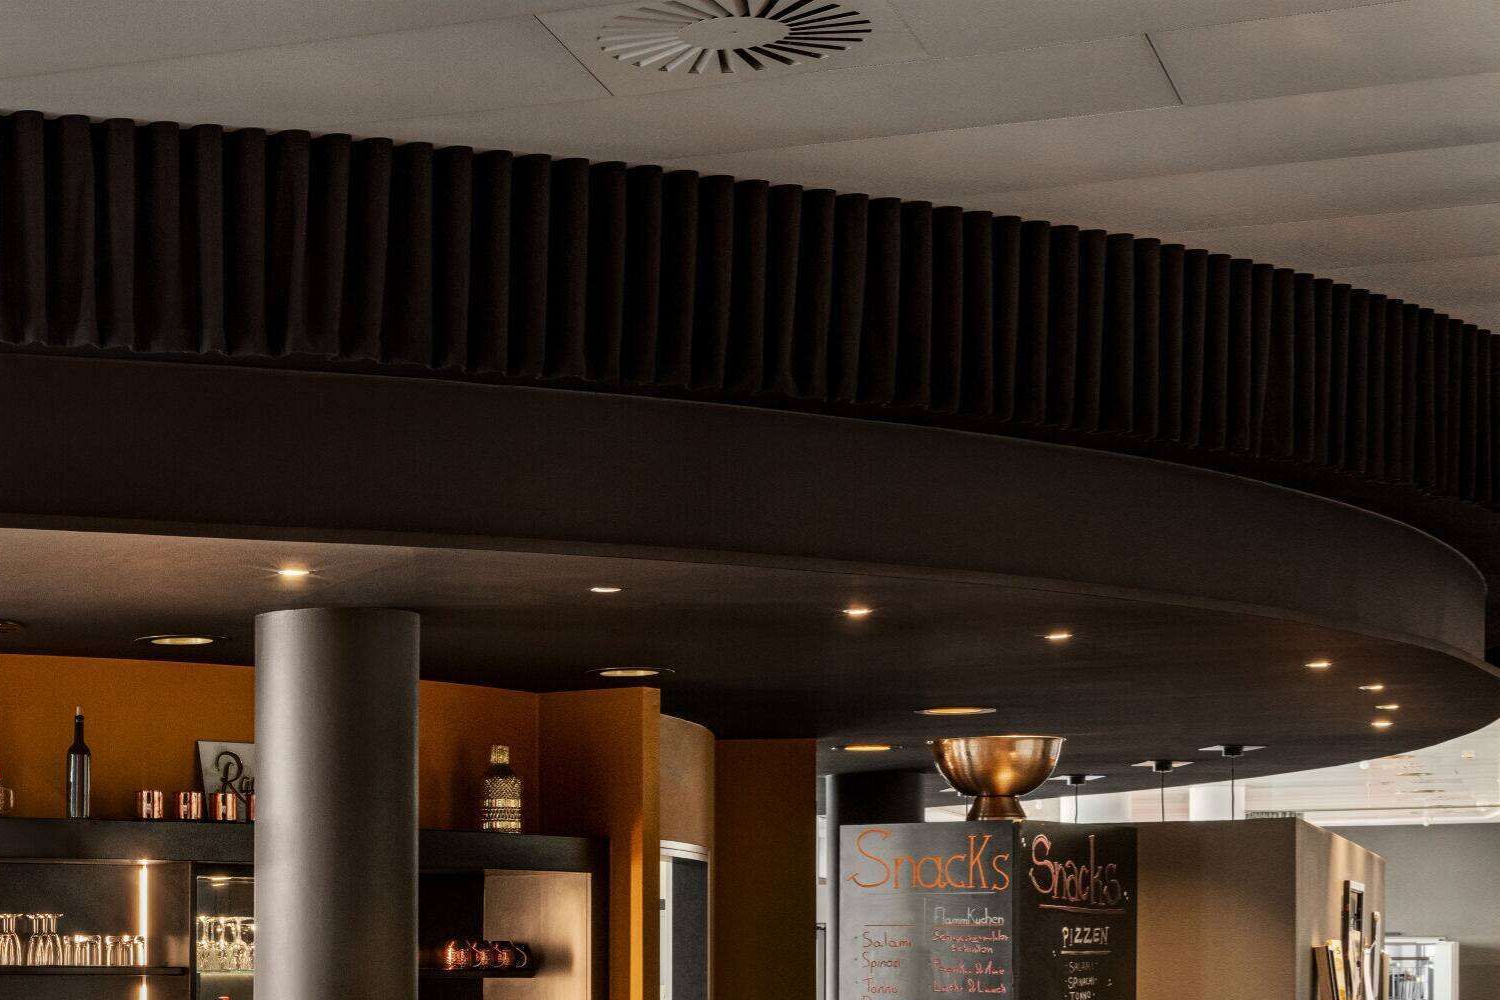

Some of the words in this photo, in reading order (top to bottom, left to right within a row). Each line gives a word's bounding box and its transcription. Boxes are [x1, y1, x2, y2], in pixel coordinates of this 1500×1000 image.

[1028, 834, 1121, 905] Snacks
[862, 931, 913, 948] Salami
[861, 976, 899, 994] Tonno
